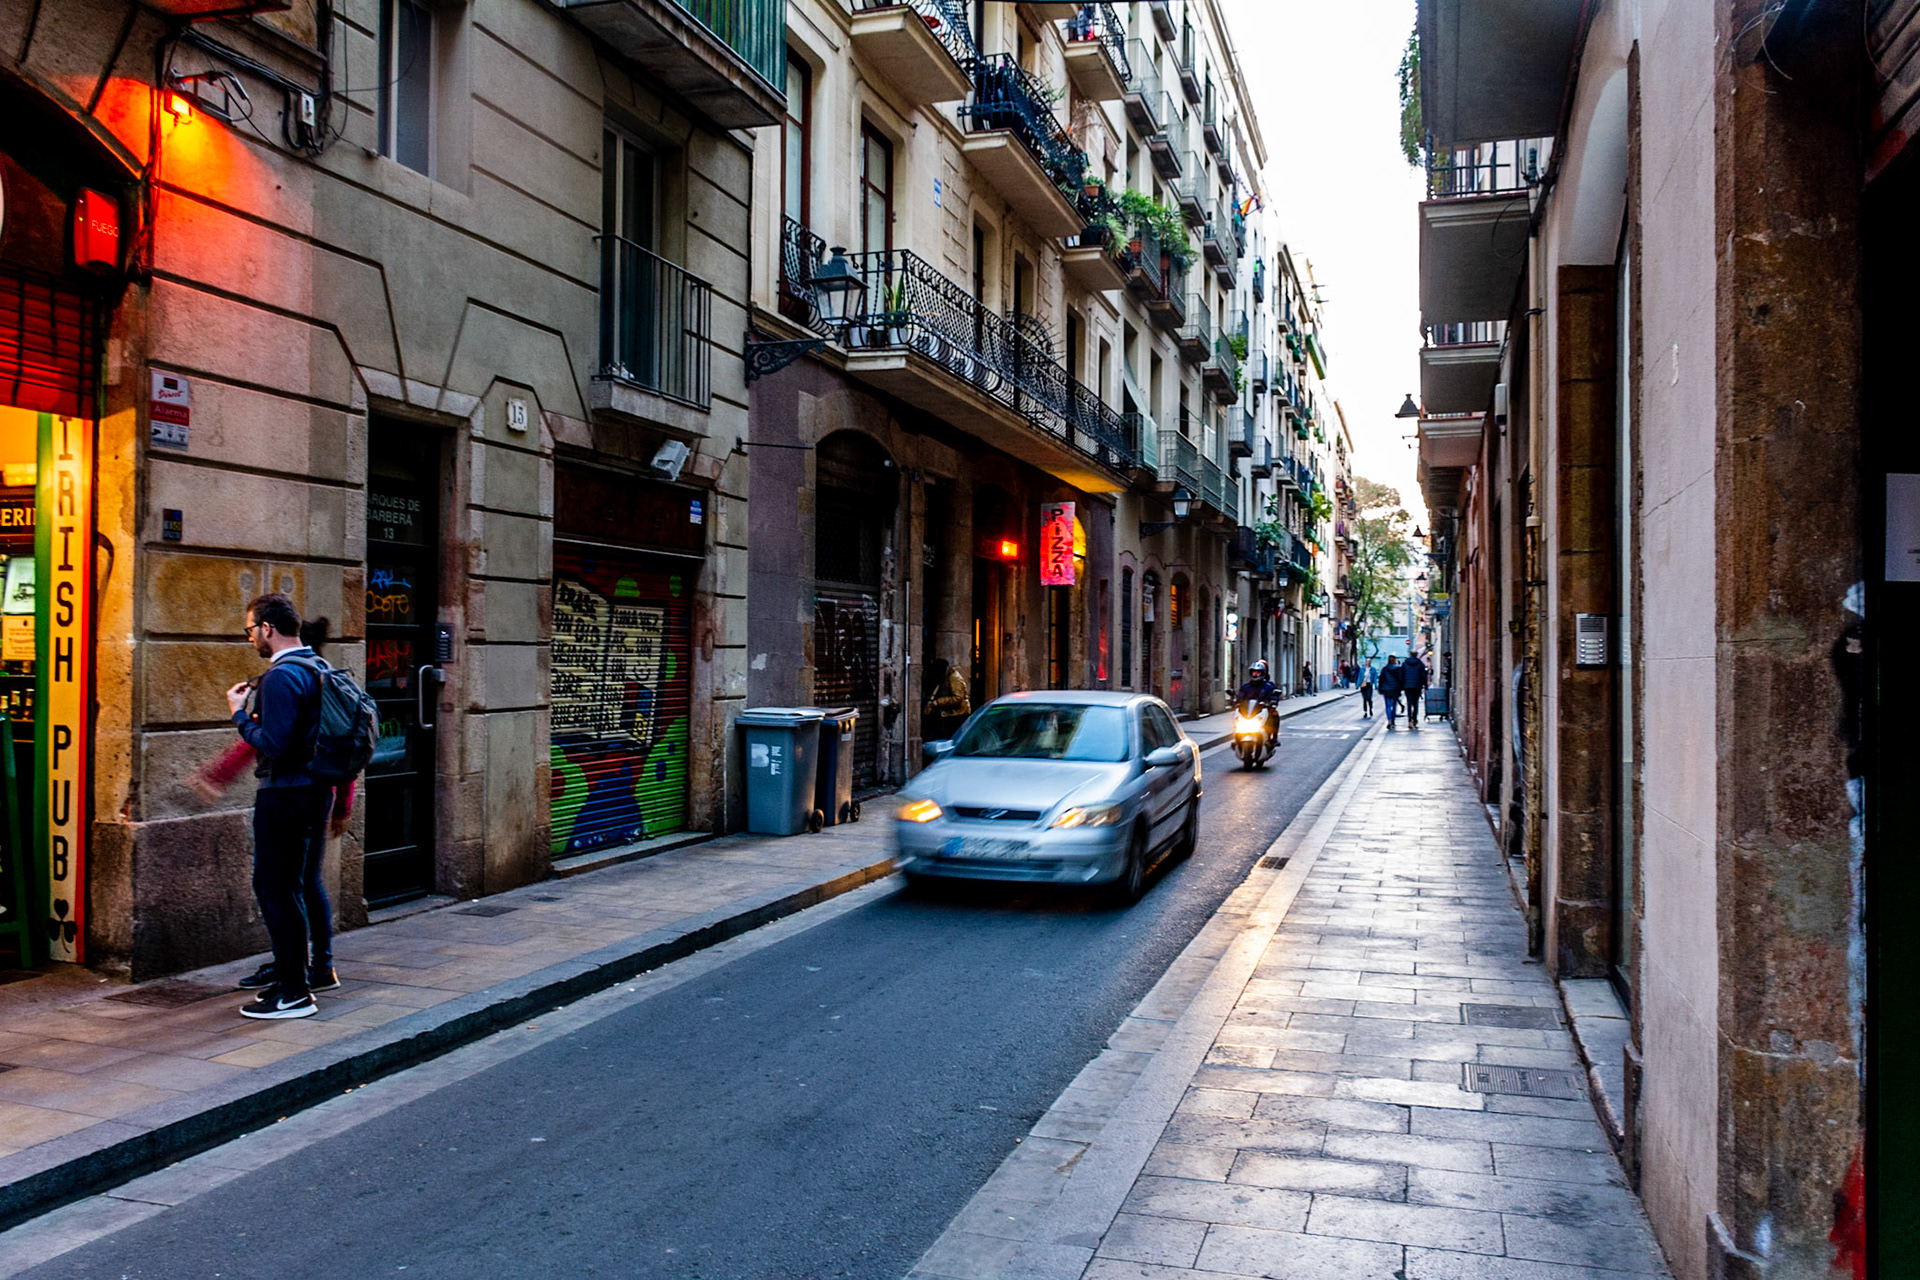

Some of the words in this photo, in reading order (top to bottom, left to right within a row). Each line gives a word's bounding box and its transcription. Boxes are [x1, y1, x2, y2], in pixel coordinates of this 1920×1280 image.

[92, 220, 118, 237] FUEGO
[154, 404, 188, 419] Alarma
[407, 499, 421, 512] DE
[383, 527, 395, 539] 13
[55, 415, 75, 682] IRISH
[52, 724, 72, 882] PUB
